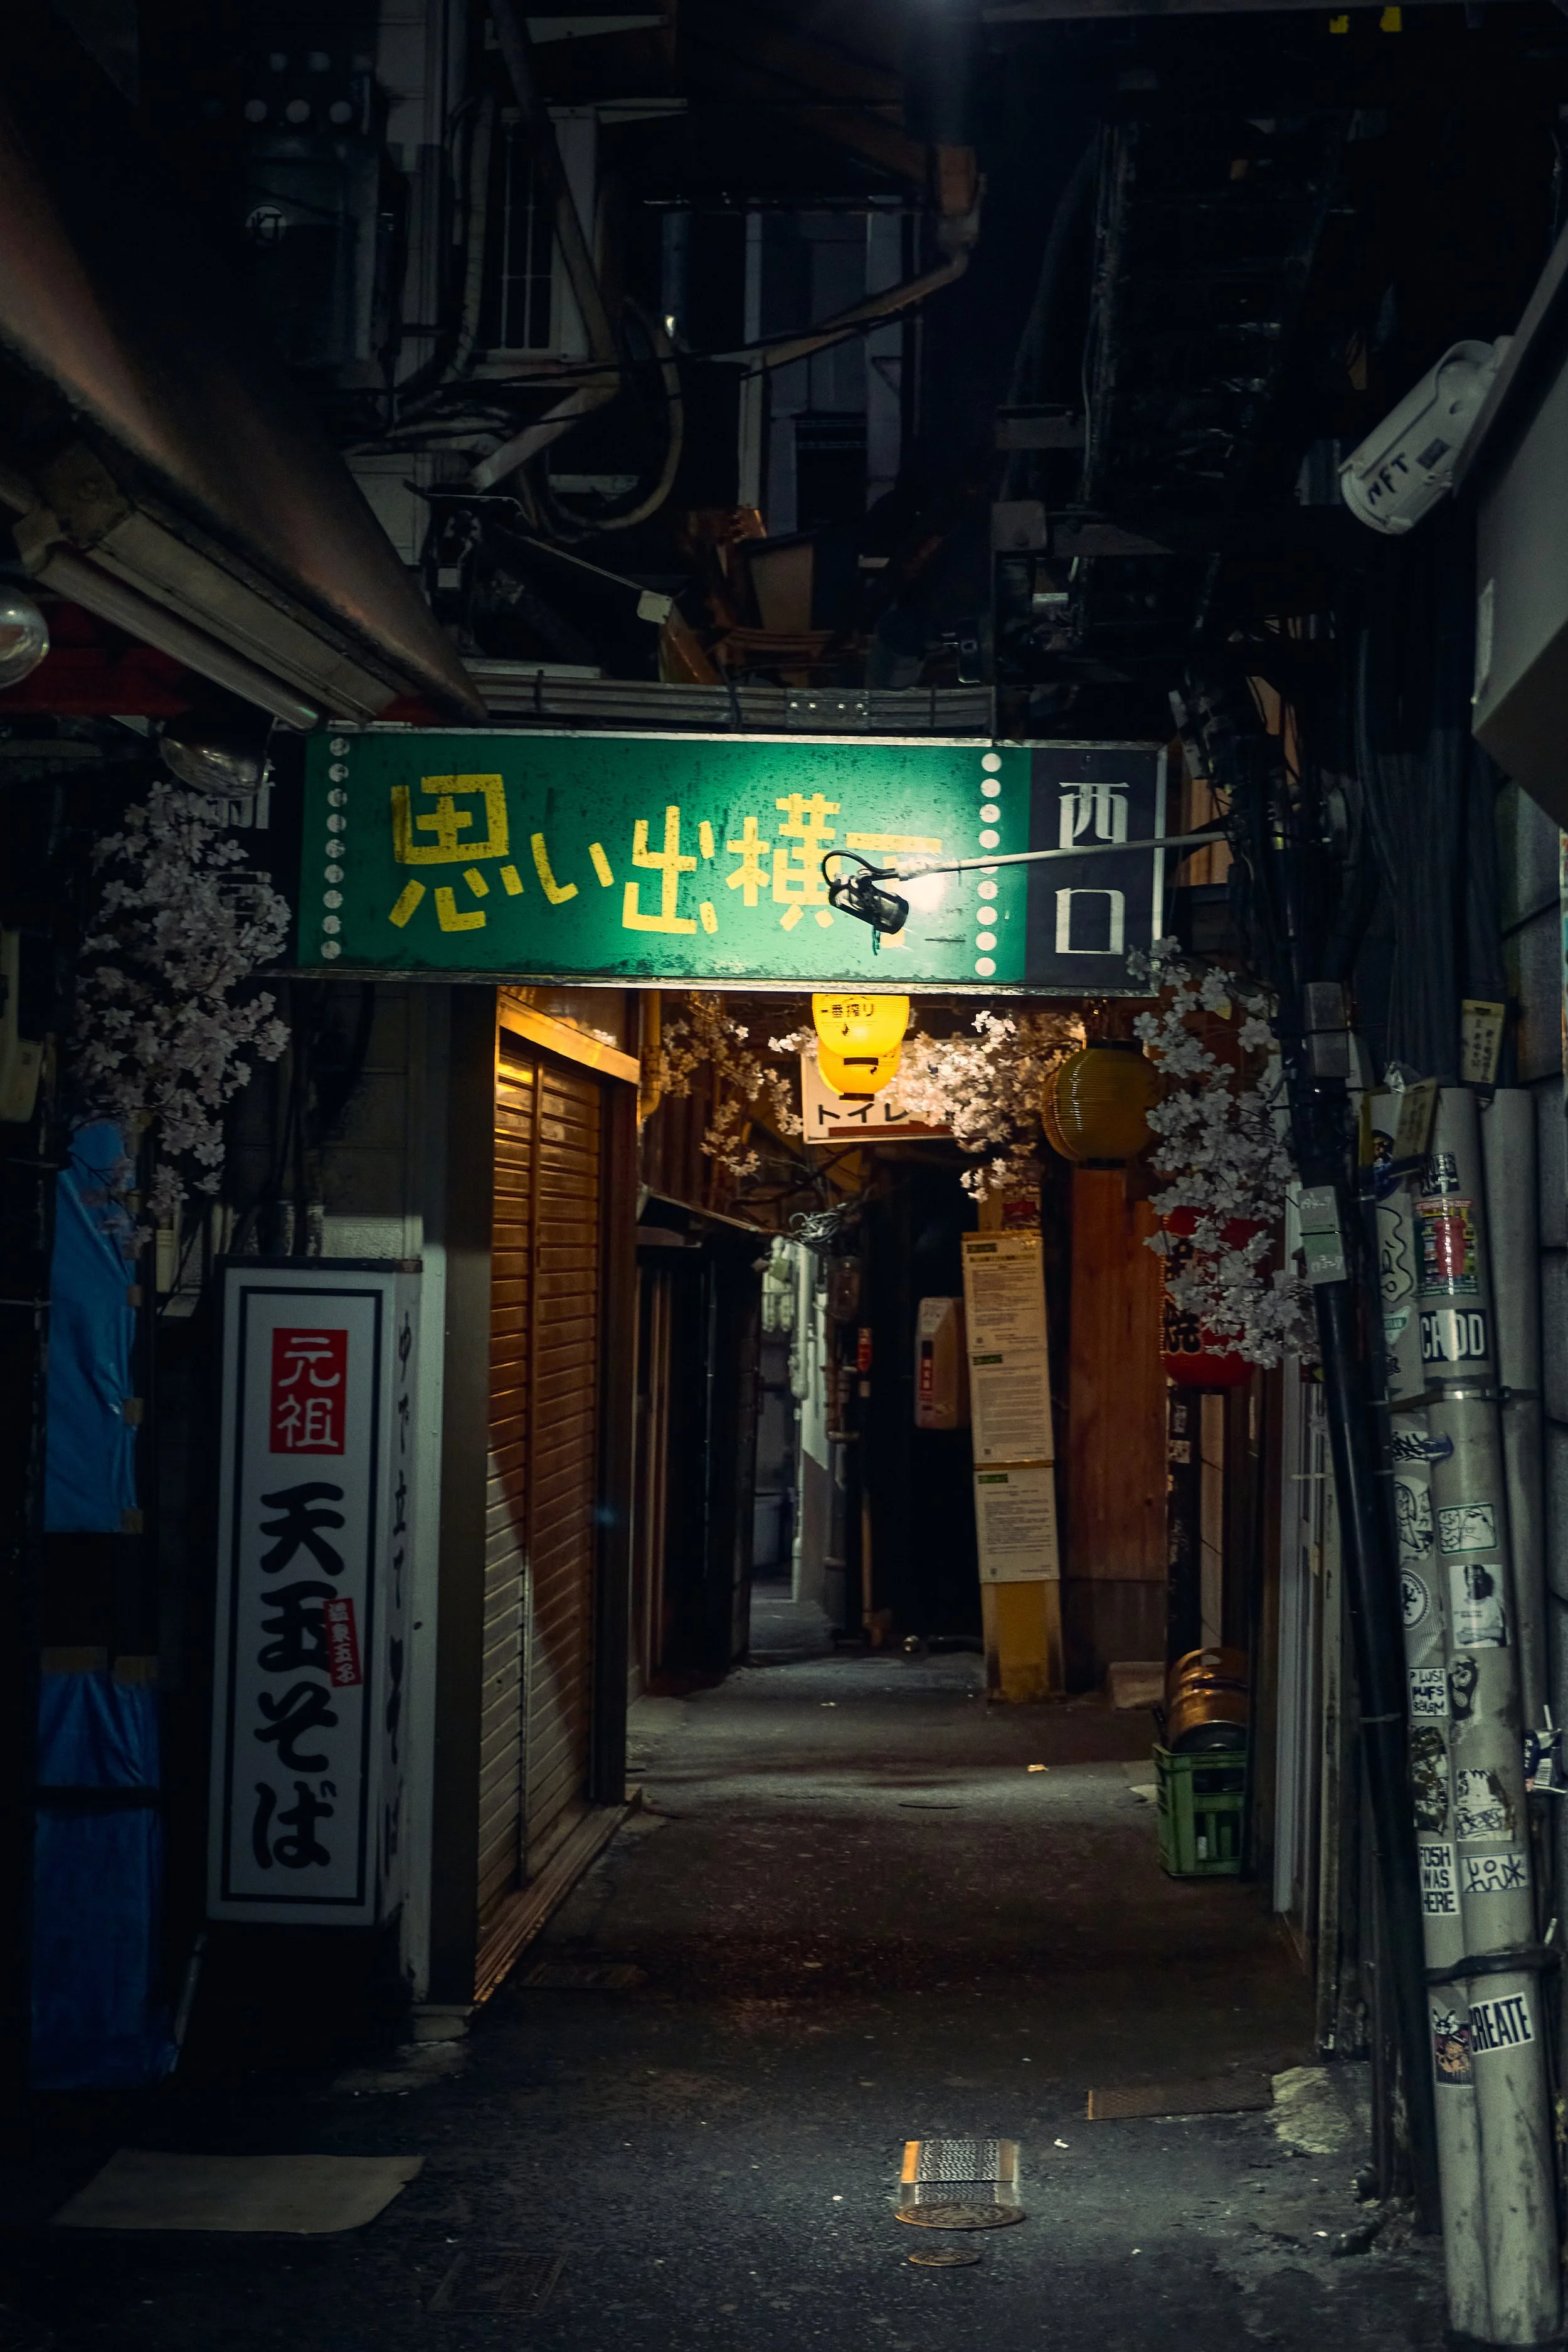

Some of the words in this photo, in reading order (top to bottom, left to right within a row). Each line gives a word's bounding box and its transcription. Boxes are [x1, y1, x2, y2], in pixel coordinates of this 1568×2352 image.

[388, 774, 942, 948] 思い出横丁
[1054, 781, 1130, 955] 西口
[817, 1102, 909, 1125] トイレ
[277, 1336, 341, 1448] 元祖
[252, 1481, 346, 1870] 天玉そば
[1421, 1868, 1450, 1889] WAS
[1422, 1890, 1456, 1913] HERE
[1468, 1996, 1532, 2052] CREATE
